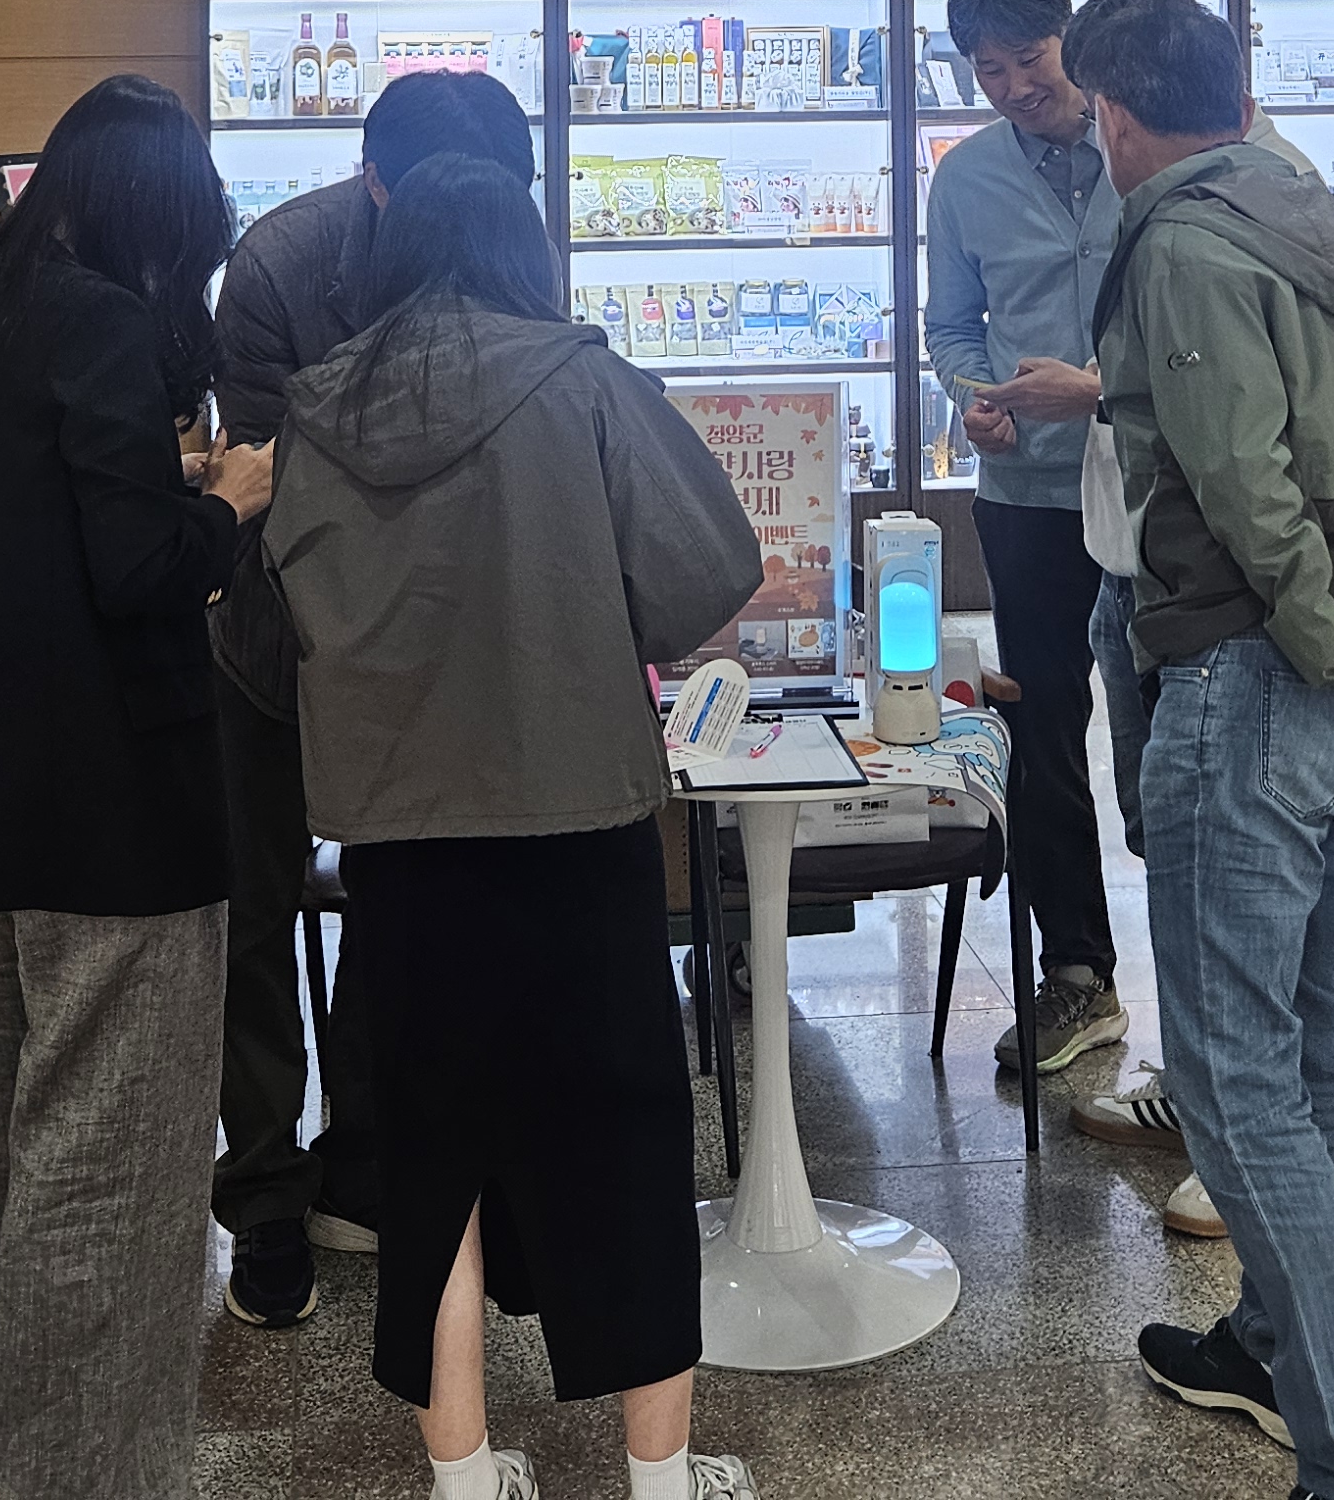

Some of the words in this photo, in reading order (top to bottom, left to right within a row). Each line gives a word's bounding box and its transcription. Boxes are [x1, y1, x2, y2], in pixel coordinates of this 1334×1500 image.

[706, 423, 764, 445] 청양군
[711, 450, 796, 481] 향사랑
[753, 525, 808, 545] 이벤트
